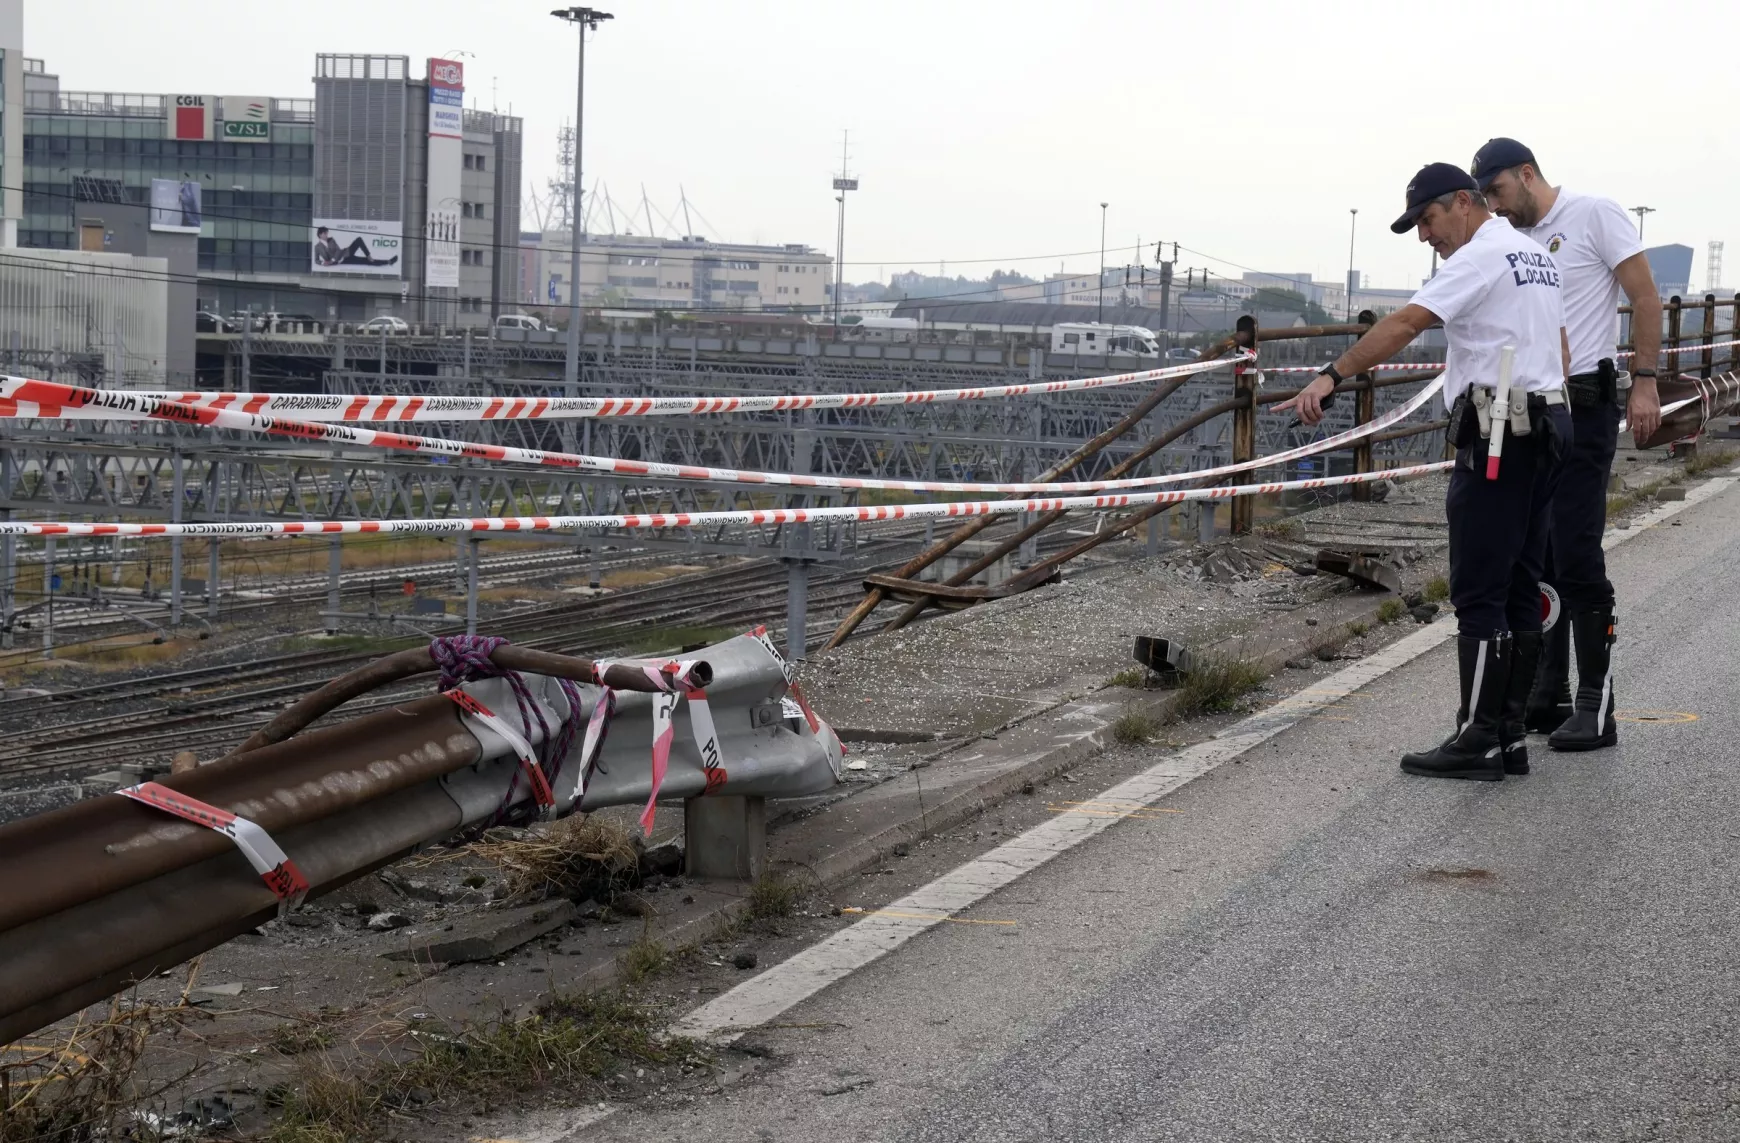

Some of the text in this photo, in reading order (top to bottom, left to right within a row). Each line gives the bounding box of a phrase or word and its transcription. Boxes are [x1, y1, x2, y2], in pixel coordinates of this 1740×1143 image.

[434, 64, 461, 84] MEGA
[176, 95, 204, 106] CGIL
[225, 123, 266, 135] CISL
[372, 237, 398, 247] nico
[1505, 251, 1556, 270] POLIZIA
[1513, 267, 1560, 288] LOCALE
[271, 395, 343, 410] CARABINIERI
[426, 398, 483, 411] CARABINIERI
[551, 399, 597, 410] CARABINIERI
